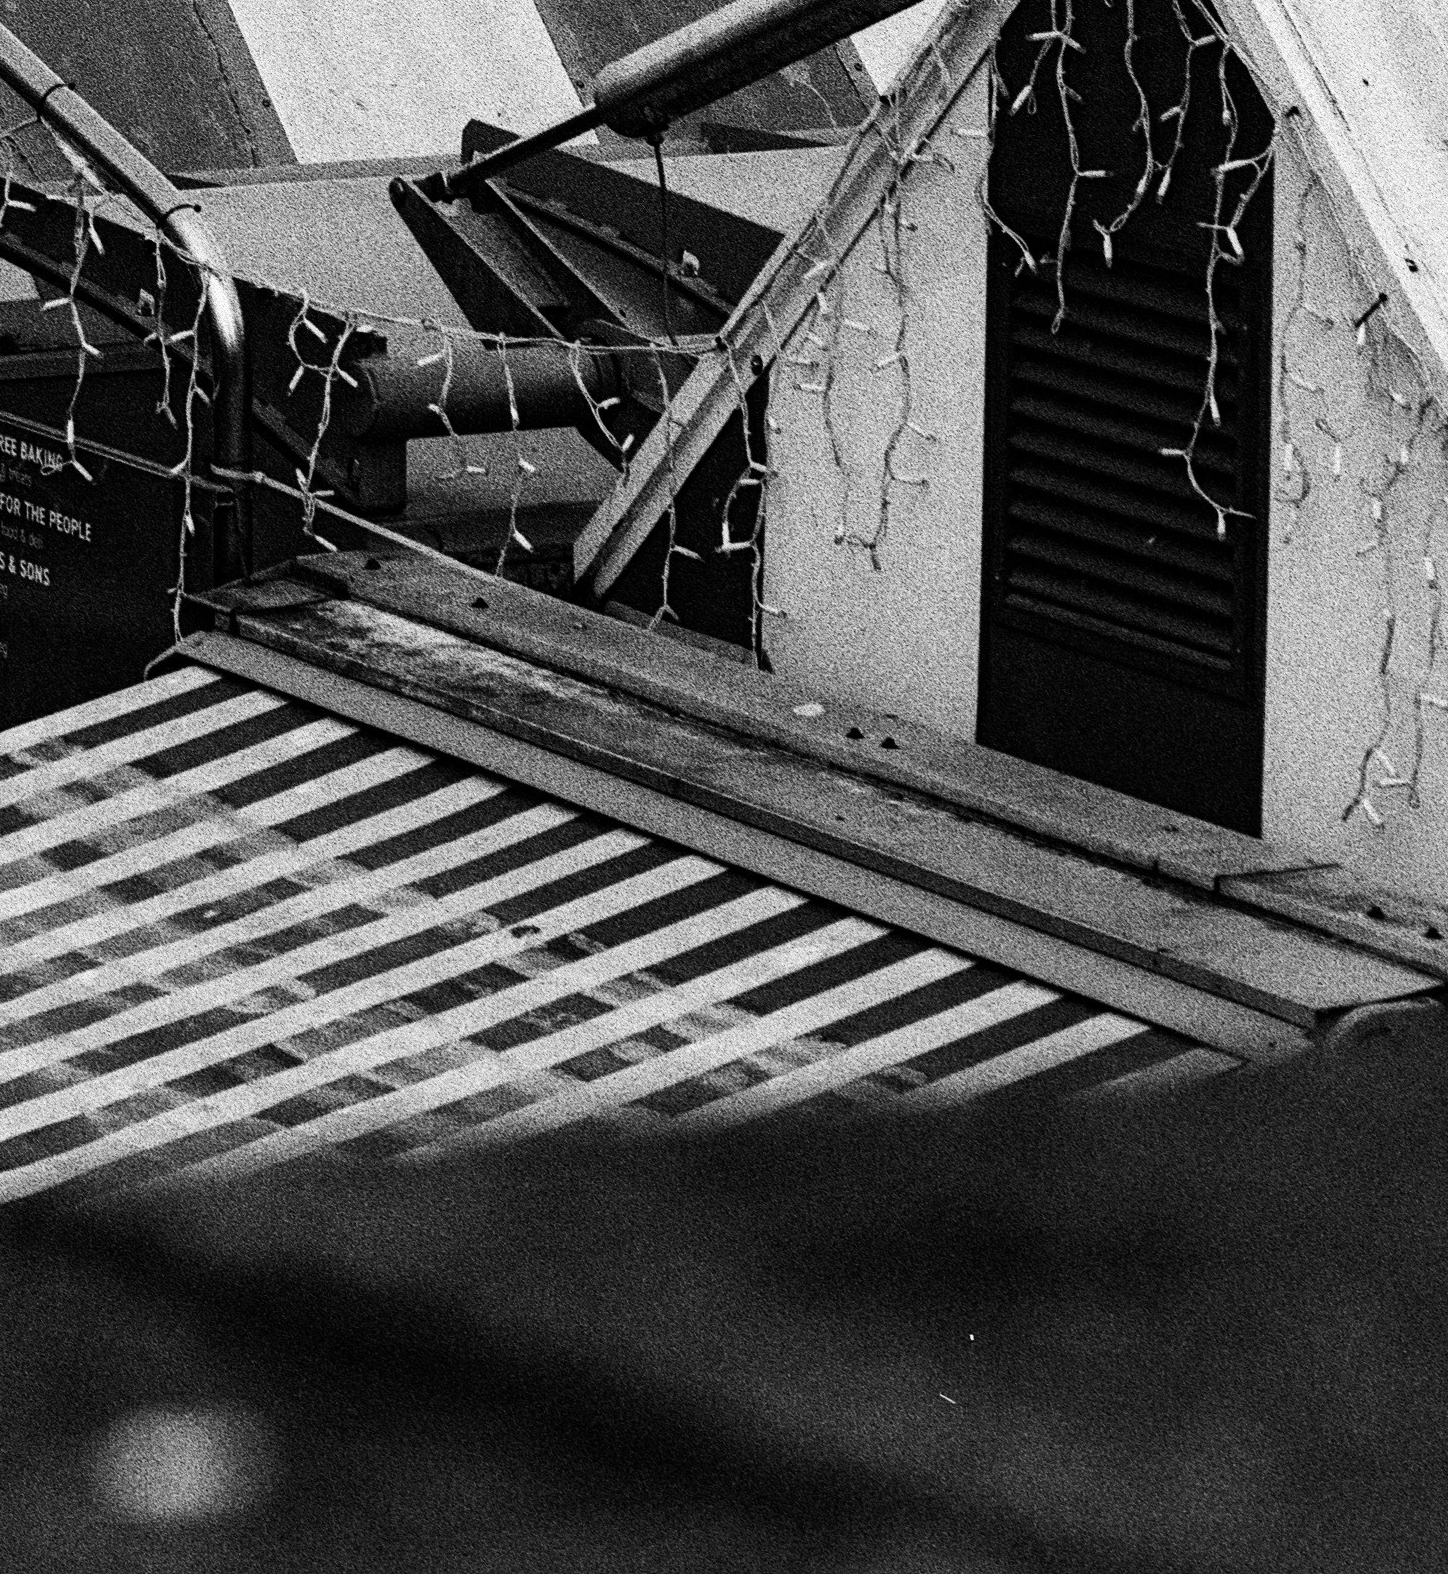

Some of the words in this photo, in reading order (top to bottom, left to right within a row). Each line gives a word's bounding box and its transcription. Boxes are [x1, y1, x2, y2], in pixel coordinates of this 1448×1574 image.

[20, 441, 64, 474] BAKING
[23, 500, 46, 527] THE
[49, 509, 92, 544] PEOPLE
[8, 554, 17, 576] &
[19, 557, 51, 588] SONS
